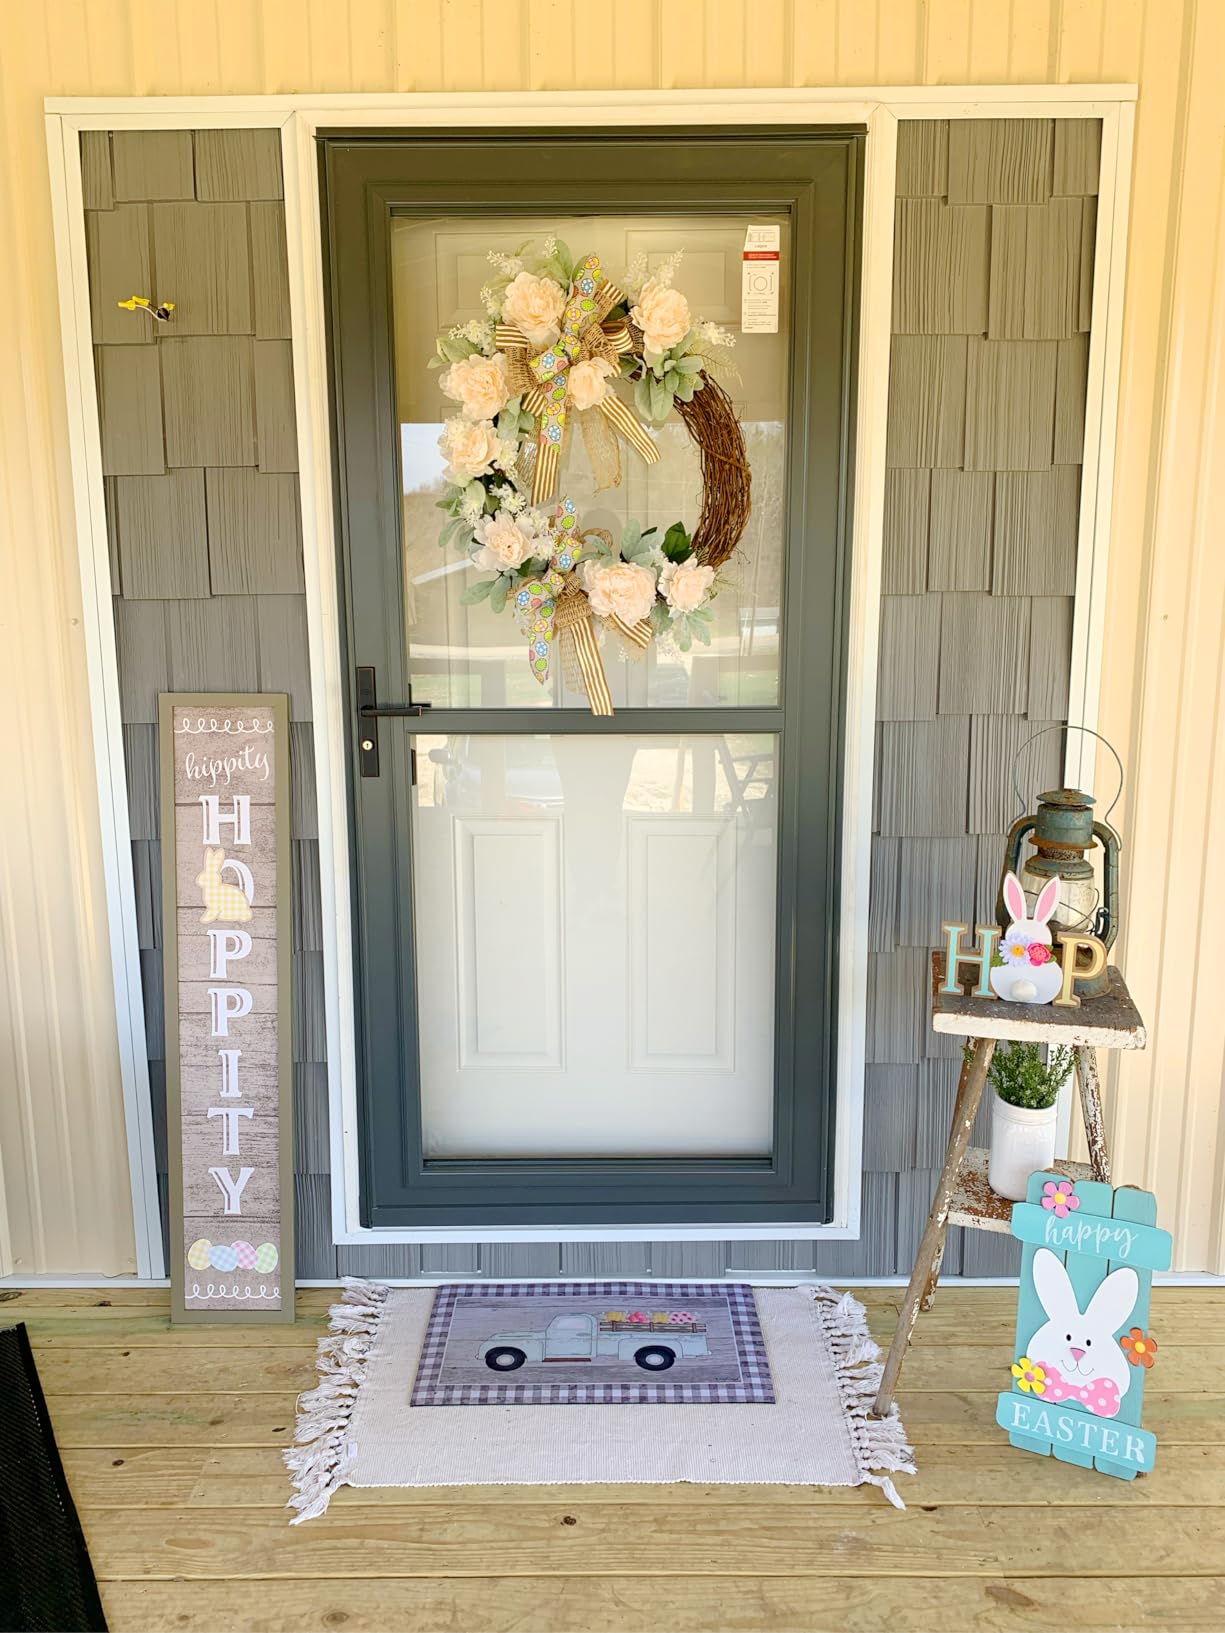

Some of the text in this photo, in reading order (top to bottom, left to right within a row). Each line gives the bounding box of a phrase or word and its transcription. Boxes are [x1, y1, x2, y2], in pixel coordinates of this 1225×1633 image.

[185, 745, 270, 787] hippity
[939, 923, 1108, 1008] HP
[1045, 1216, 1137, 1258] happy
[1010, 1402, 1145, 1464] EASTER
